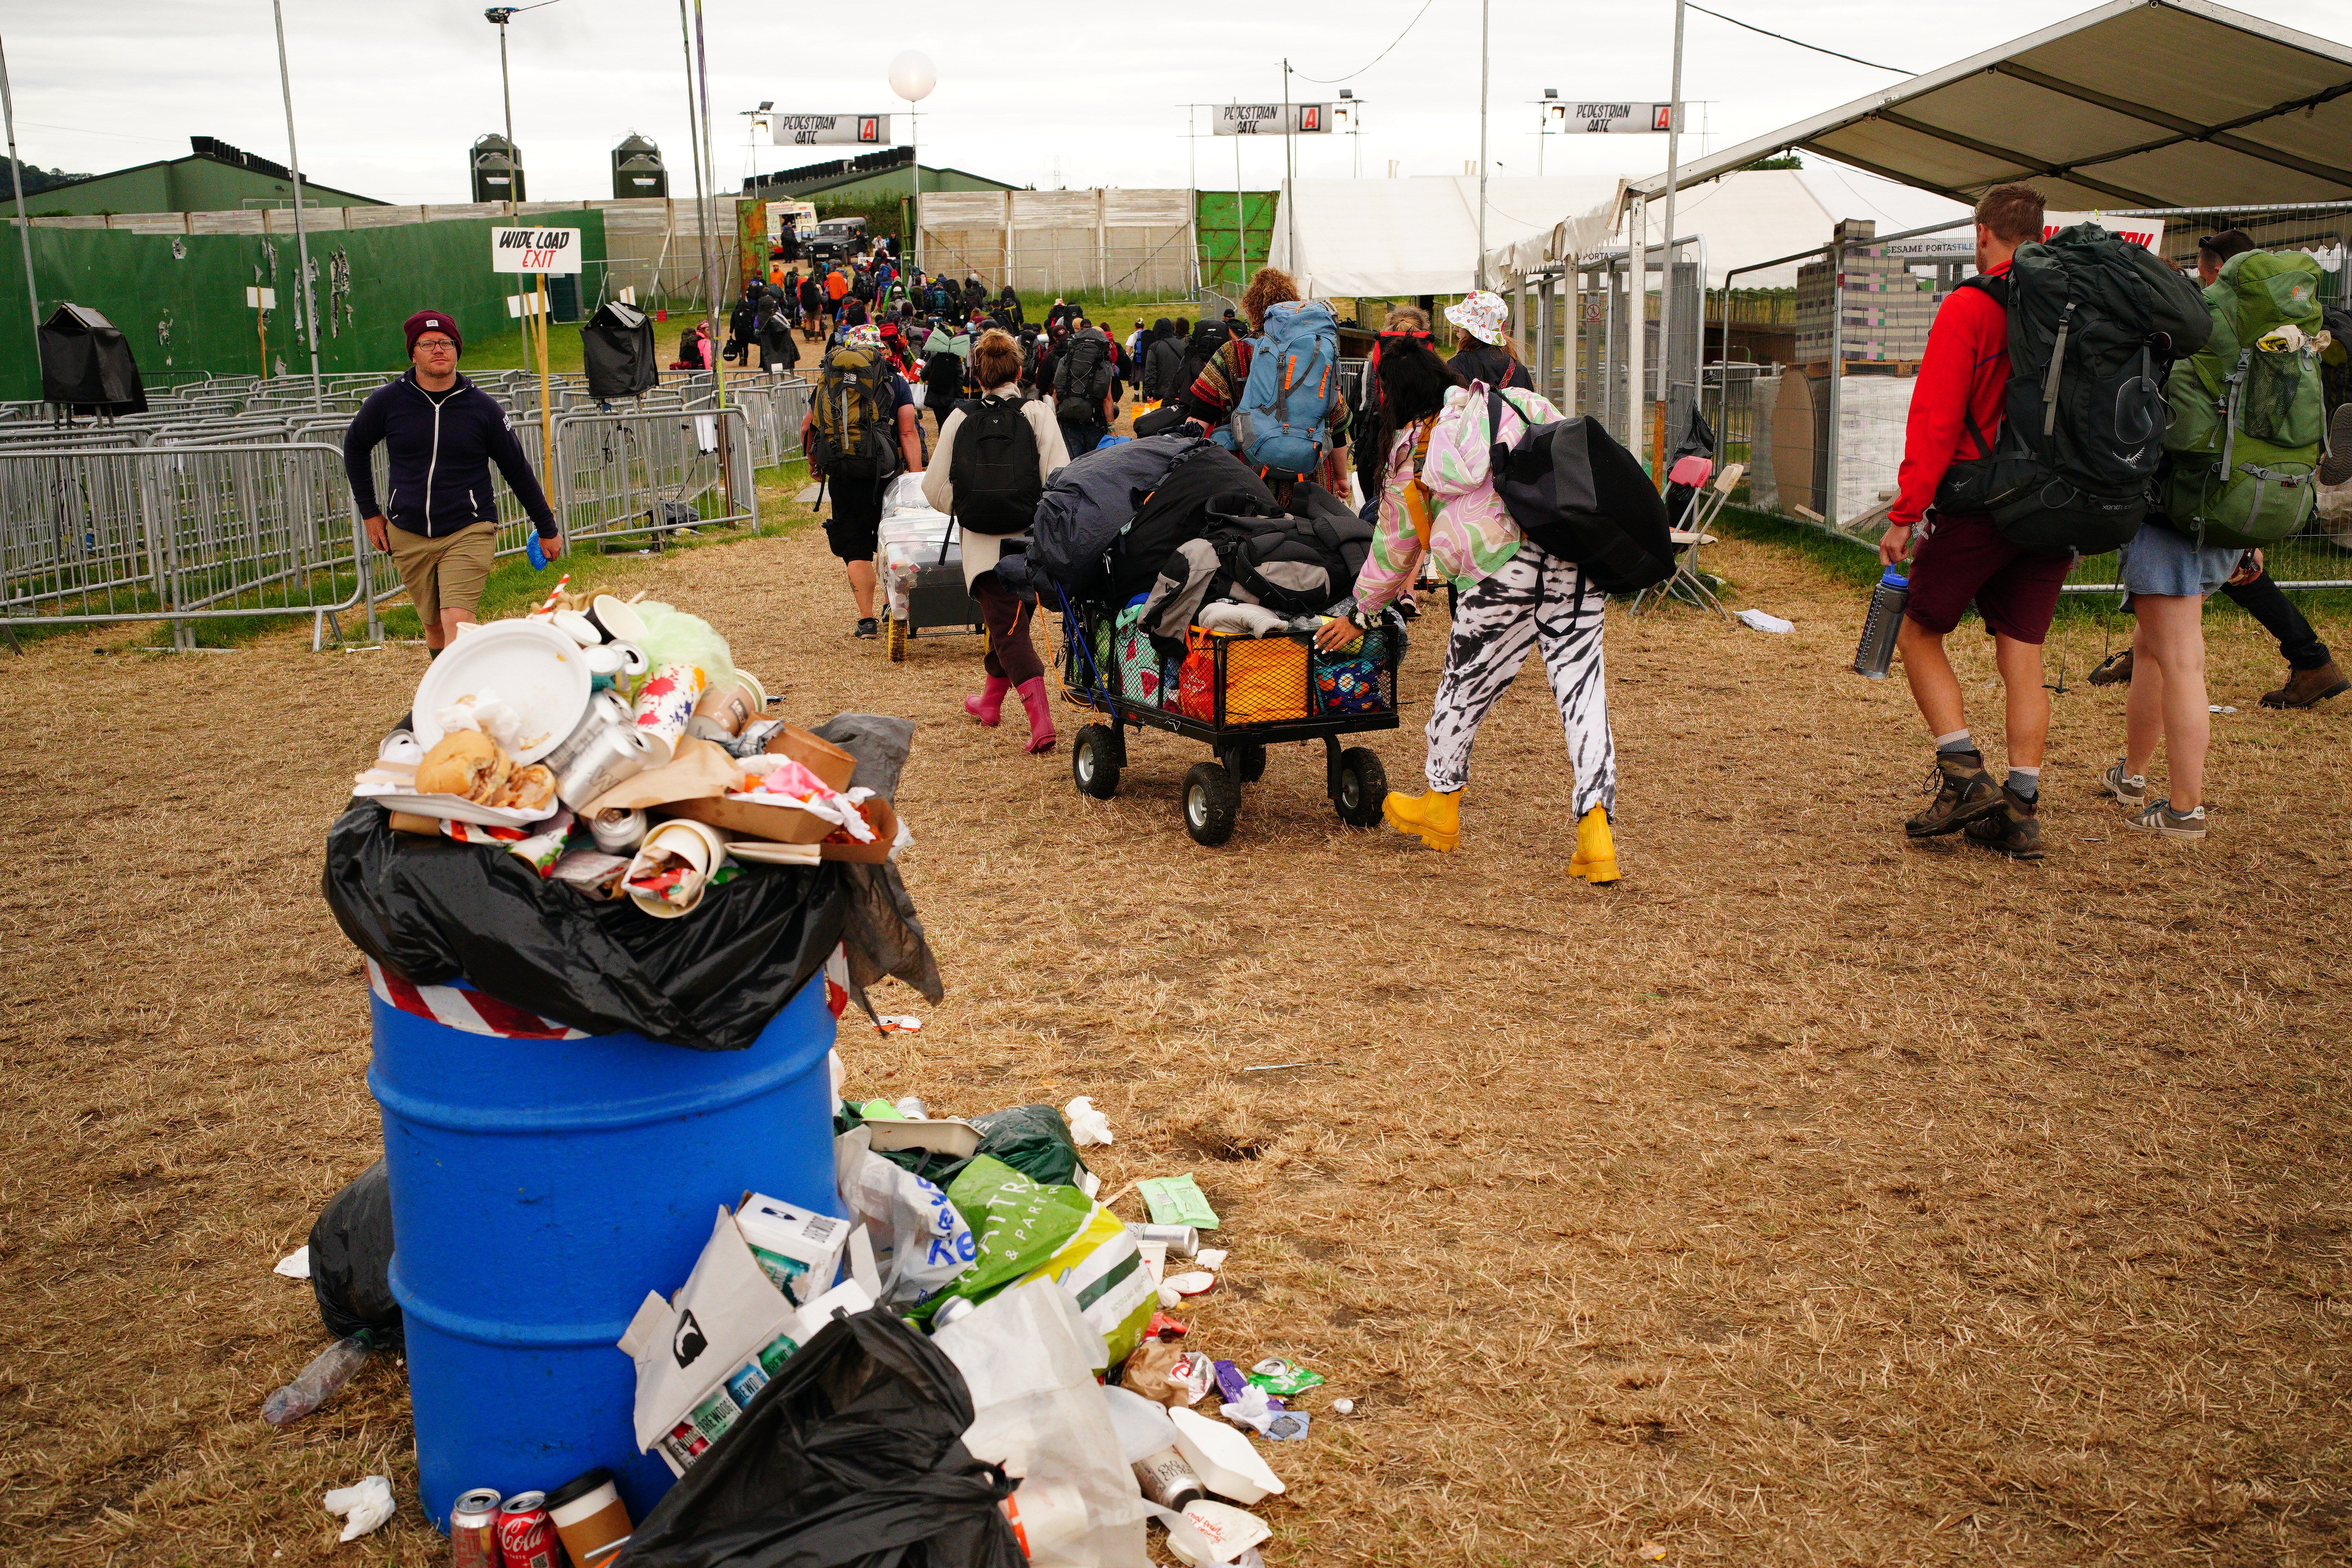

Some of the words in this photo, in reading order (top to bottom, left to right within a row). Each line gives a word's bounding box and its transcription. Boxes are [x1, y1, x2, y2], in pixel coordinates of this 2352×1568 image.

[1224, 106, 1278, 120] PEDESTRIAN
[1305, 108, 1316, 128] A
[1577, 104, 1631, 118] PEDESTRIAN
[1657, 108, 1669, 127] A
[1587, 119, 1612, 132] GATE
[783, 116, 837, 130] PEDESTRIAN
[863, 119, 874, 140] A
[795, 131, 817, 145] GATE
[499, 231, 534, 248] WIDE
[536, 231, 570, 249] LOAD
[1887, 245, 1922, 254] SESAME
[523, 250, 556, 268] EXIT
[698, 1399, 734, 1433] BREWDOG
[502, 1512, 546, 1552] Cola
